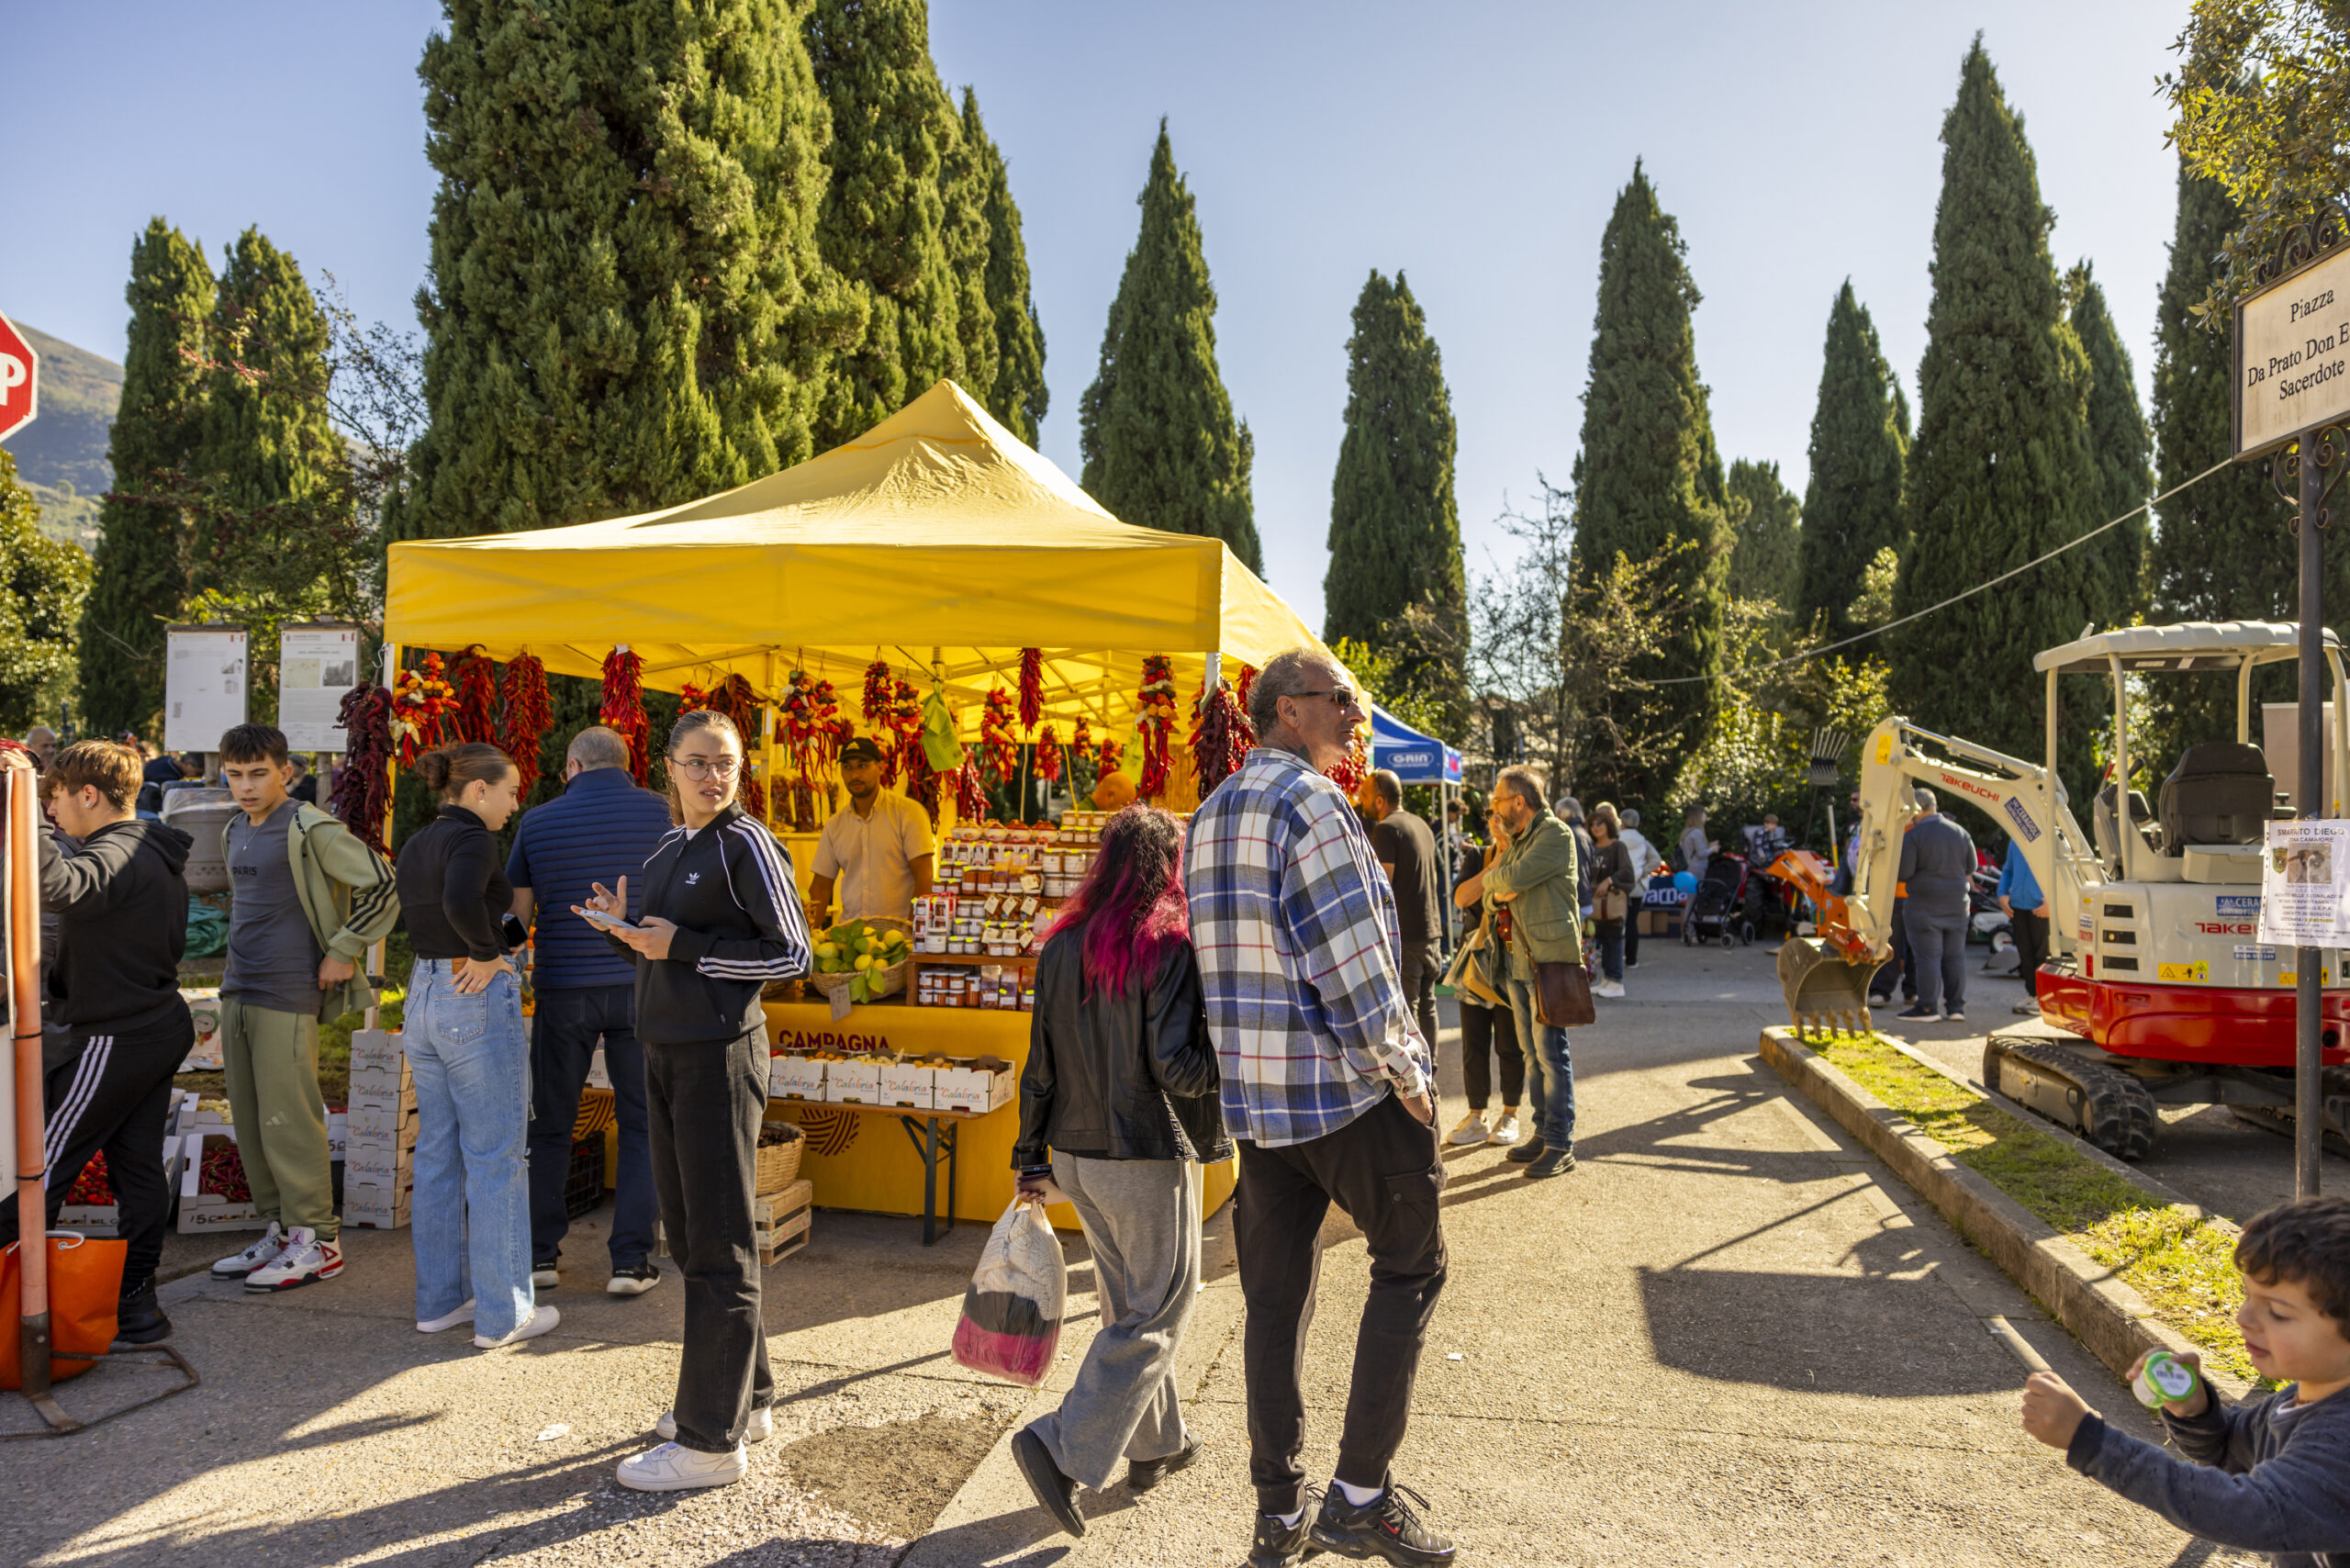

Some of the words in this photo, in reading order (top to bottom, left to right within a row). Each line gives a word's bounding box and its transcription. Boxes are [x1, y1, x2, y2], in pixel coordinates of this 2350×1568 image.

[2290, 289, 2334, 323] Piazza
[2247, 367, 2265, 387] Da
[2268, 351, 2301, 378] Prato
[2306, 335, 2334, 361] Don
[2279, 360, 2344, 400] Sacerdote
[232, 866, 257, 876] PARIS
[2195, 923, 2257, 935] TAKE
[778, 1030, 890, 1051] CAMPAGNA
[778, 1075, 814, 1089] Calabria
[835, 1077, 873, 1090] Calabria
[889, 1080, 926, 1092] Calabria
[941, 1086, 979, 1100] Calabria
